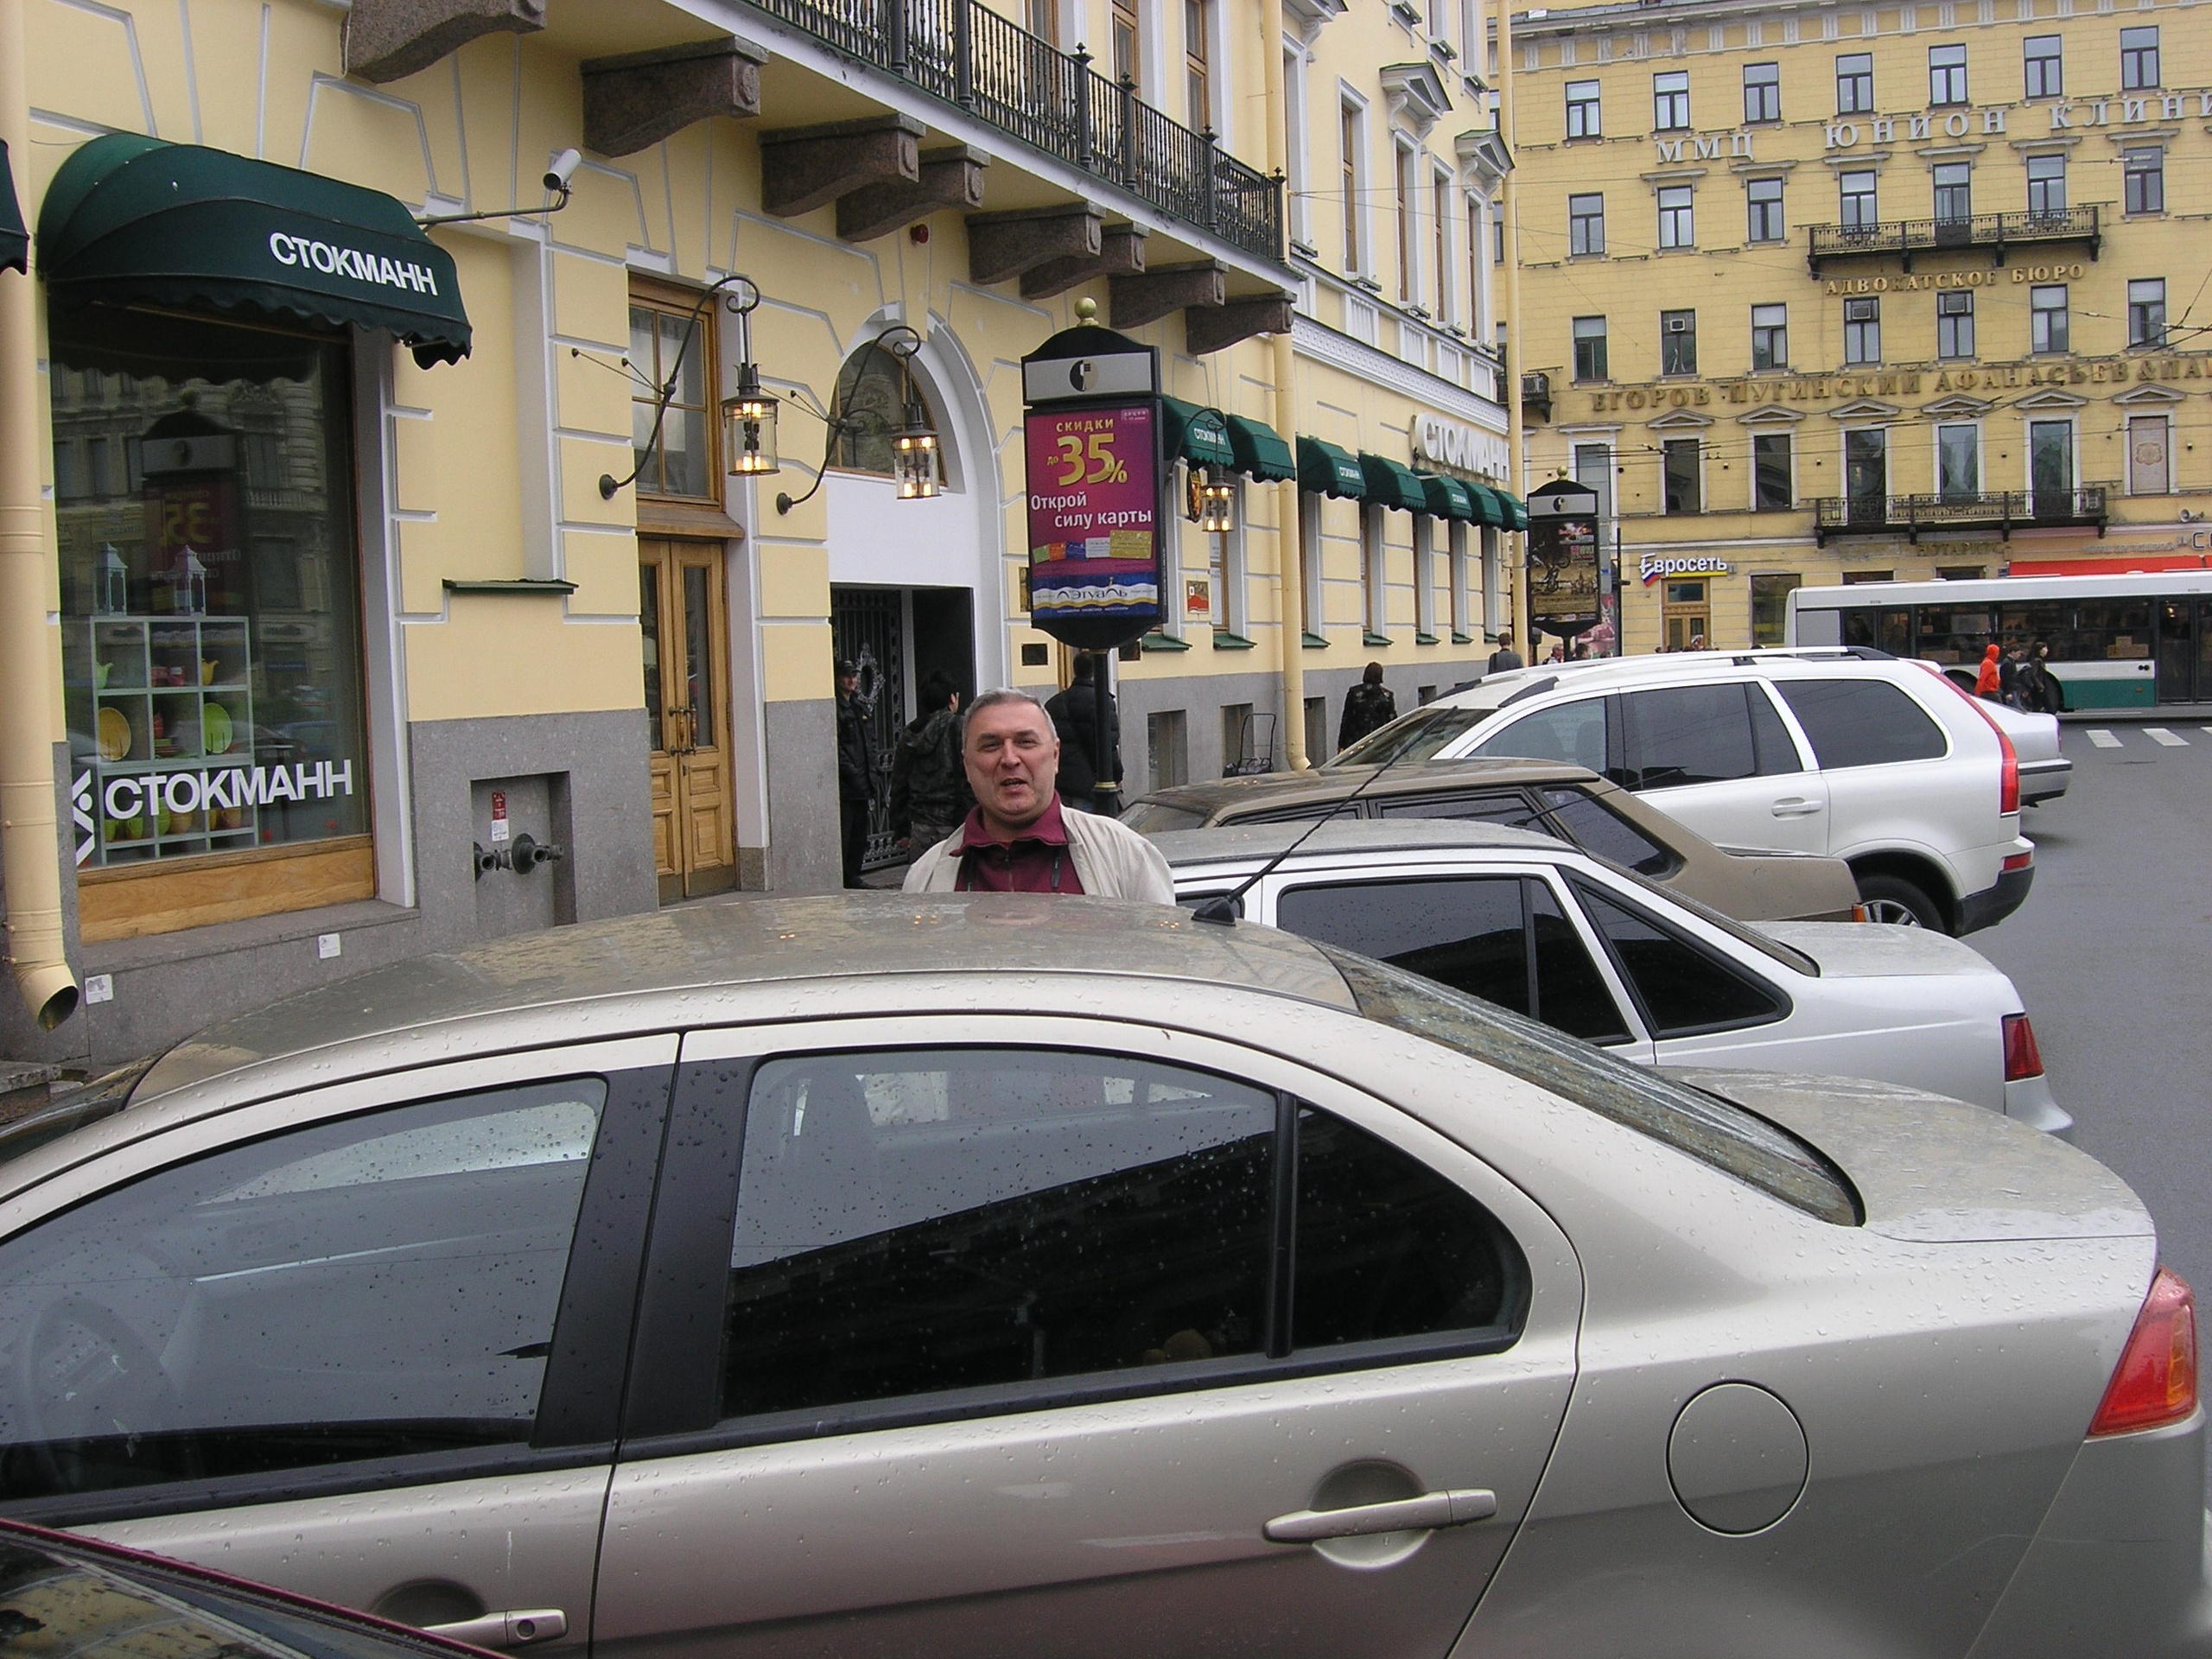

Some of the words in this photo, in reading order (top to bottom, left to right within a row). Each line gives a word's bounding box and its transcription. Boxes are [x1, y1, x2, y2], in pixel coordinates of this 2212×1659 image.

[1656, 131, 1754, 164] ММЦ
[1824, 109, 2007, 149] ЮНИОН
[270, 232, 439, 296] СТОКМАНН
[1825, 270, 1997, 296] АДВОКАТСКОЕ
[2012, 264, 2086, 284] БЮРО
[1591, 386, 1711, 411] ЕГОРОВ
[1729, 367, 1921, 404] ПУГИНСКИЙ
[1031, 491, 1087, 512] Открой
[1054, 513, 1093, 530] силу
[1098, 509, 1152, 527] карты
[1639, 553, 1727, 578] Евросеть
[105, 759, 353, 820] СТОКМАНН
